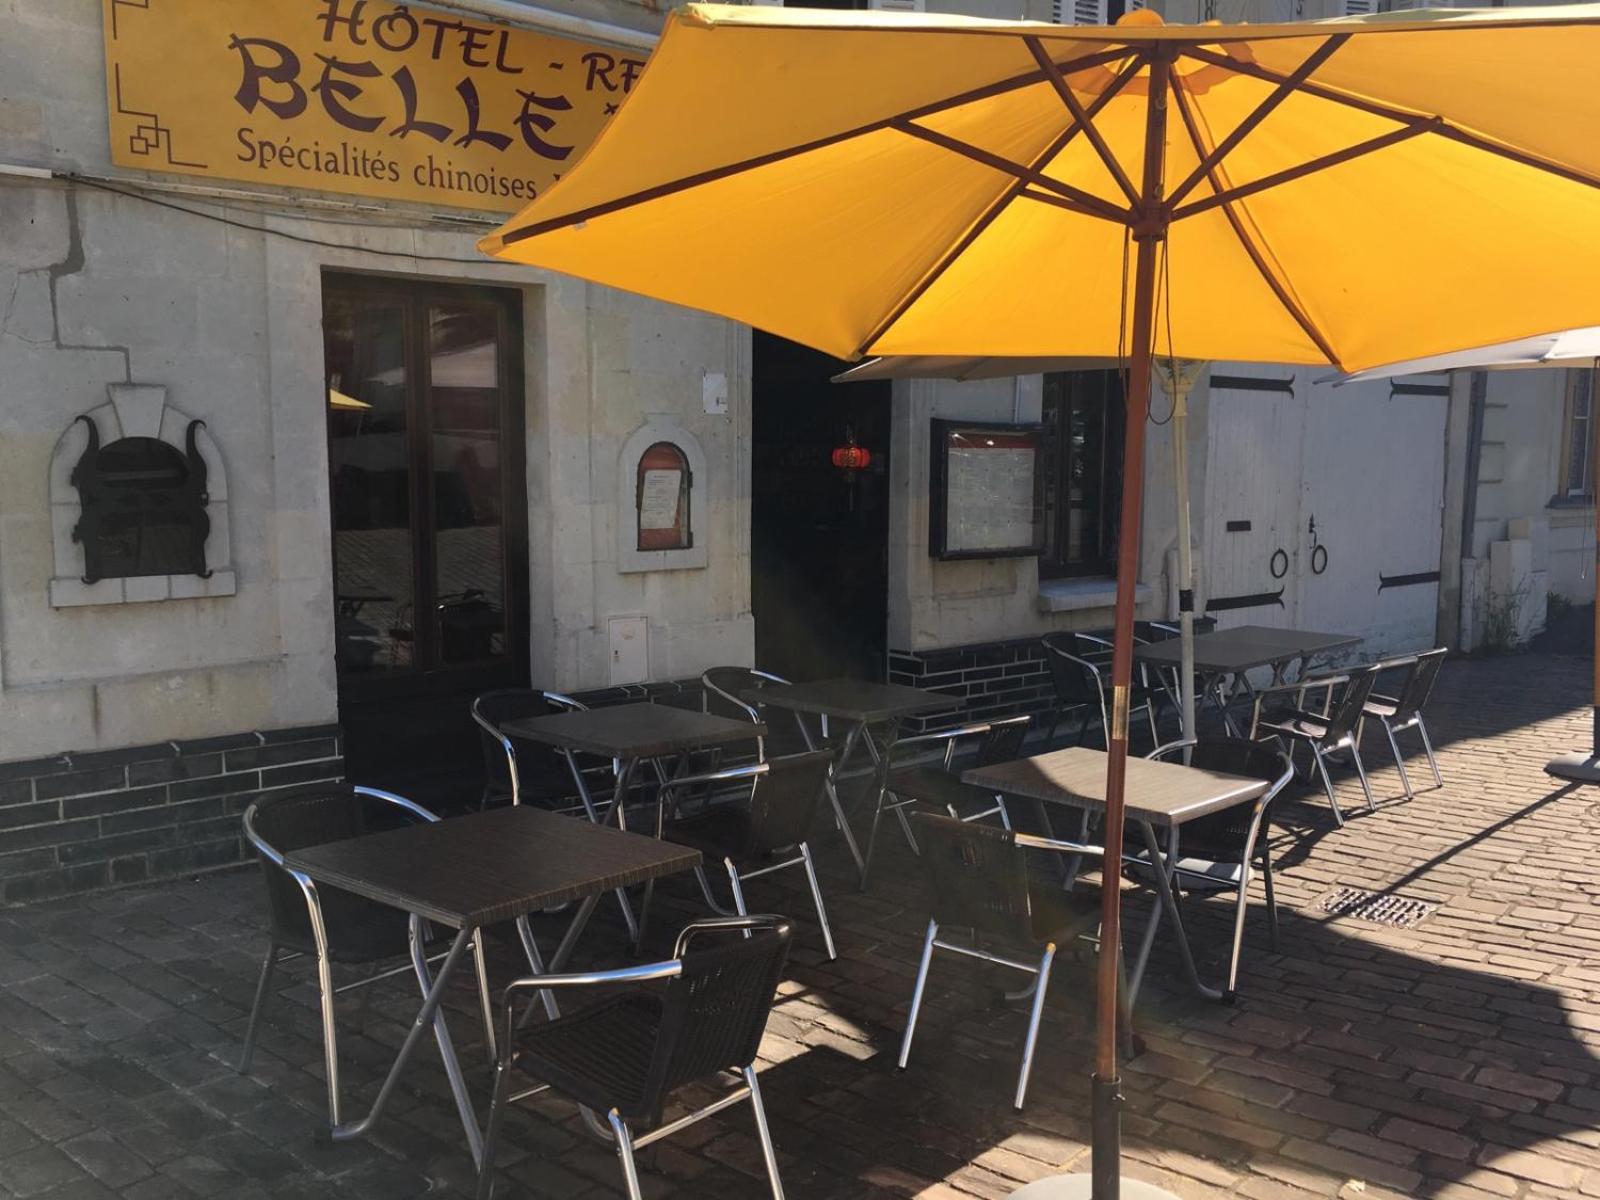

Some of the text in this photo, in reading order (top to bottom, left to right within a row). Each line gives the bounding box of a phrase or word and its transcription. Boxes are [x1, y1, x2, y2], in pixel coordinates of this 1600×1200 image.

[316, 0, 523, 74] HÔTEL
[581, 52, 647, 94] RE
[228, 33, 575, 161] BELLE
[237, 127, 537, 200] Spécialités chinoises
